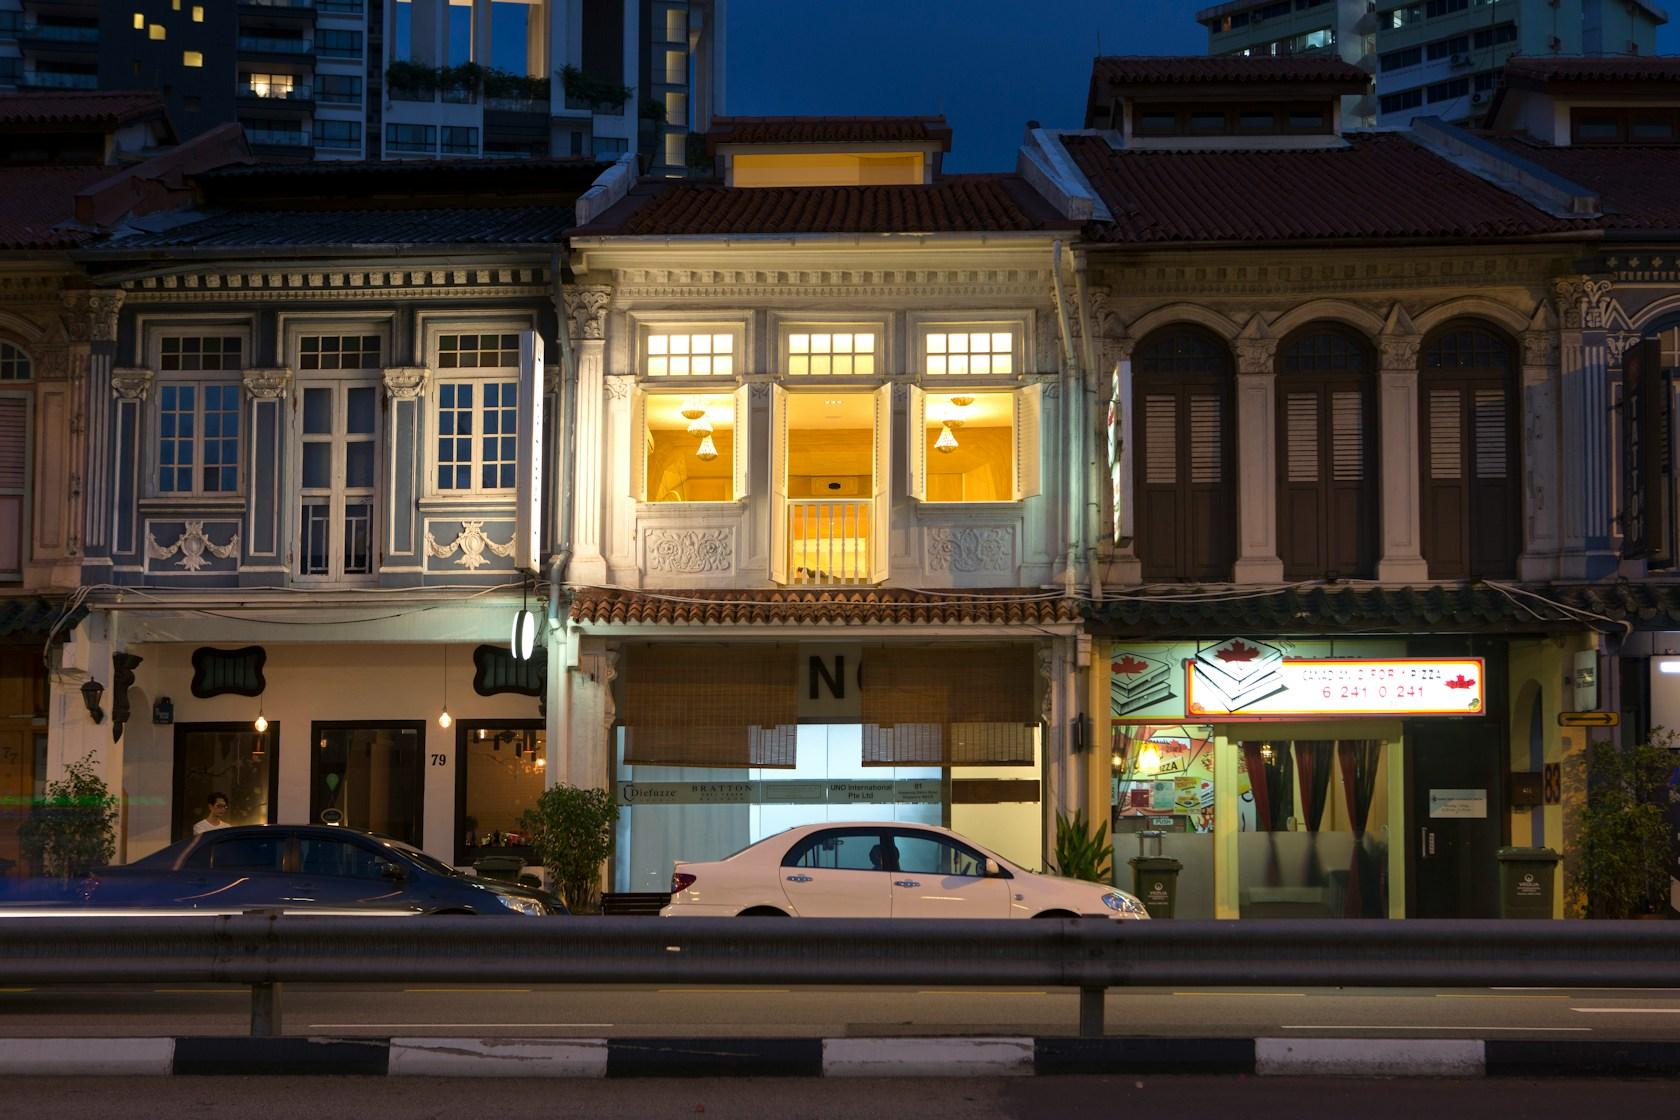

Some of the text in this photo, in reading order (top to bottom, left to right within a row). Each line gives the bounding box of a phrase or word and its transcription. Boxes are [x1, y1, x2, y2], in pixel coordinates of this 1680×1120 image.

[1303, 669, 1351, 681] CANADAN
[1411, 669, 1441, 681] PZZA
[1322, 685, 1424, 698] 6 241 0 241
[431, 754, 446, 766] 79
[1158, 761, 1178, 773] IZZA
[691, 784, 753, 793] BRATTON
[830, 784, 847, 792] UNO
[1544, 763, 1561, 803] 83
[862, 791, 874, 799] Ltd
